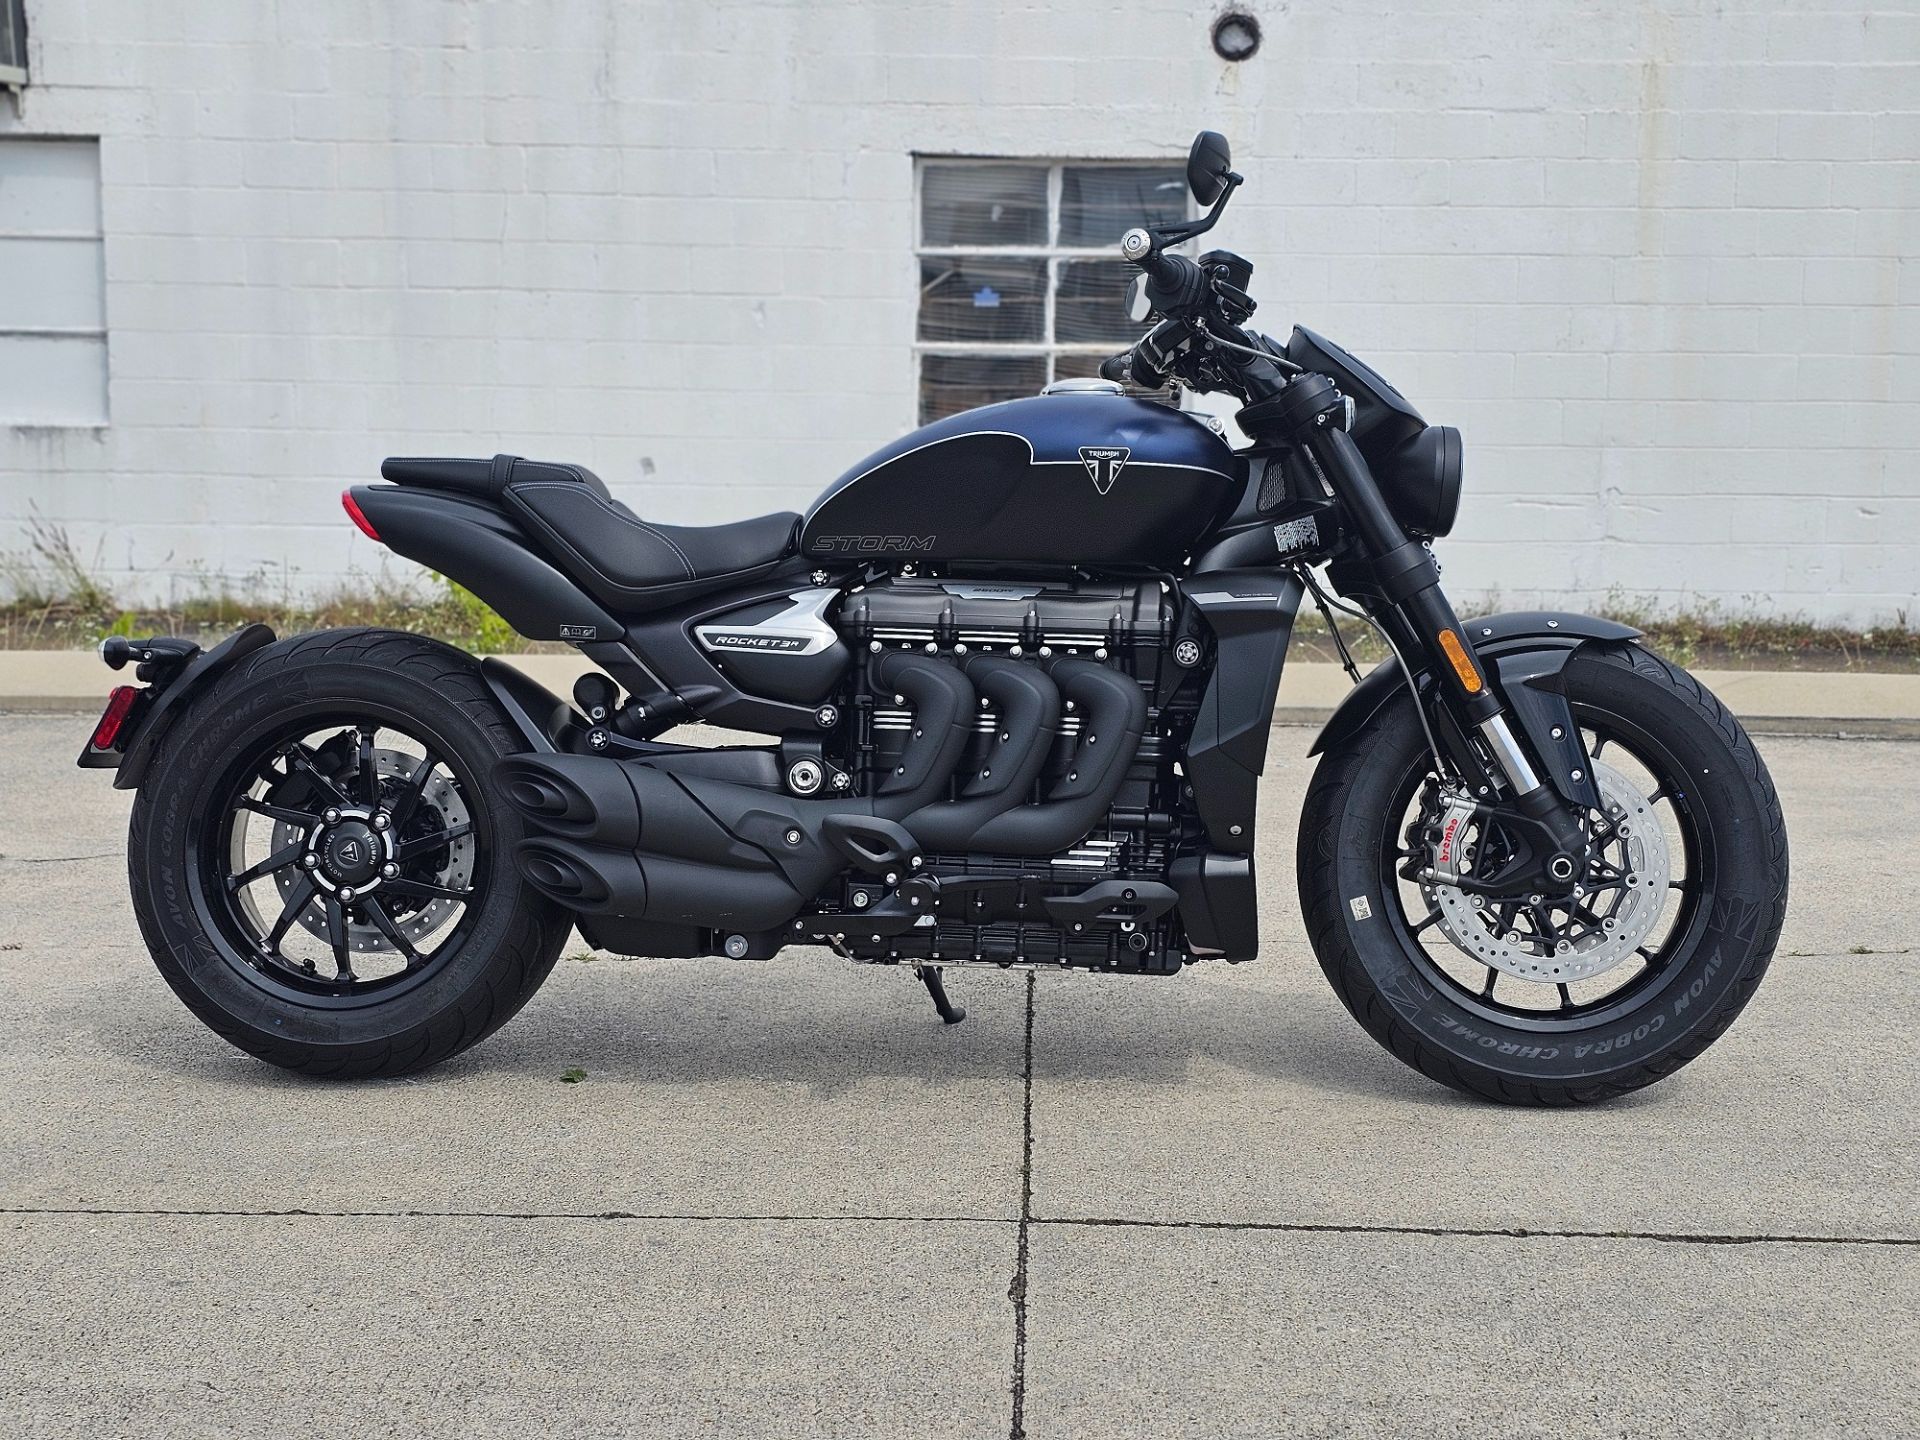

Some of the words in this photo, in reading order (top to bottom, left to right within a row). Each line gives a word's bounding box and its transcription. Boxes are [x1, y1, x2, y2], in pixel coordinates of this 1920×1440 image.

[1088, 450, 1120, 458] TRIUMPH
[811, 535, 937, 552] STORM
[362, 831, 377, 865] TRIUMPH
[1439, 818, 1458, 863] brembo
[161, 864, 188, 929] AVON
[1673, 944, 1726, 1017] AVON
[1435, 1012, 1560, 1061] CHROME
[1573, 1014, 1666, 1060] COBRA
